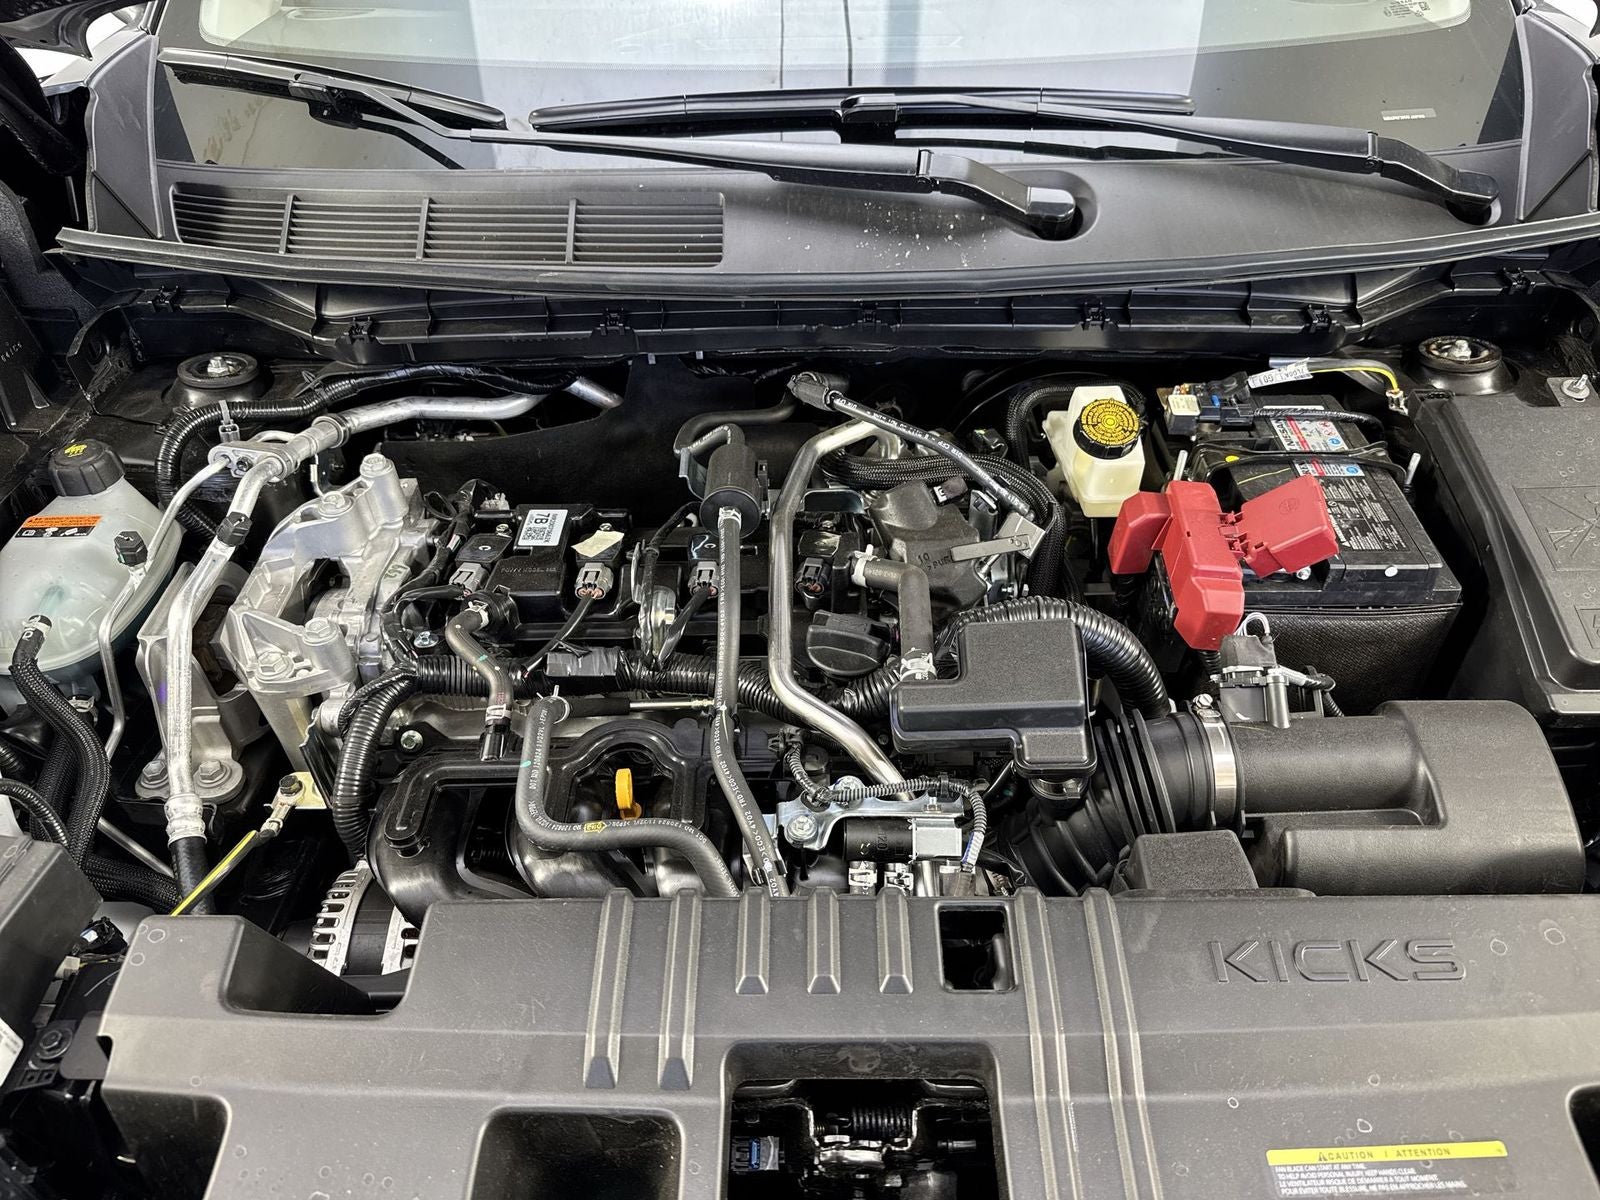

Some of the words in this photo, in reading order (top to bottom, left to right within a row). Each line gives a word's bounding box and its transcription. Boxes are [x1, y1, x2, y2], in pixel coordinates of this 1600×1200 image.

[534, 513, 551, 524] 7B
[1208, 939, 1468, 983] KICKS
[1328, 1151, 1374, 1161] CAUTION
[1396, 1147, 1451, 1158] ATTENTION
